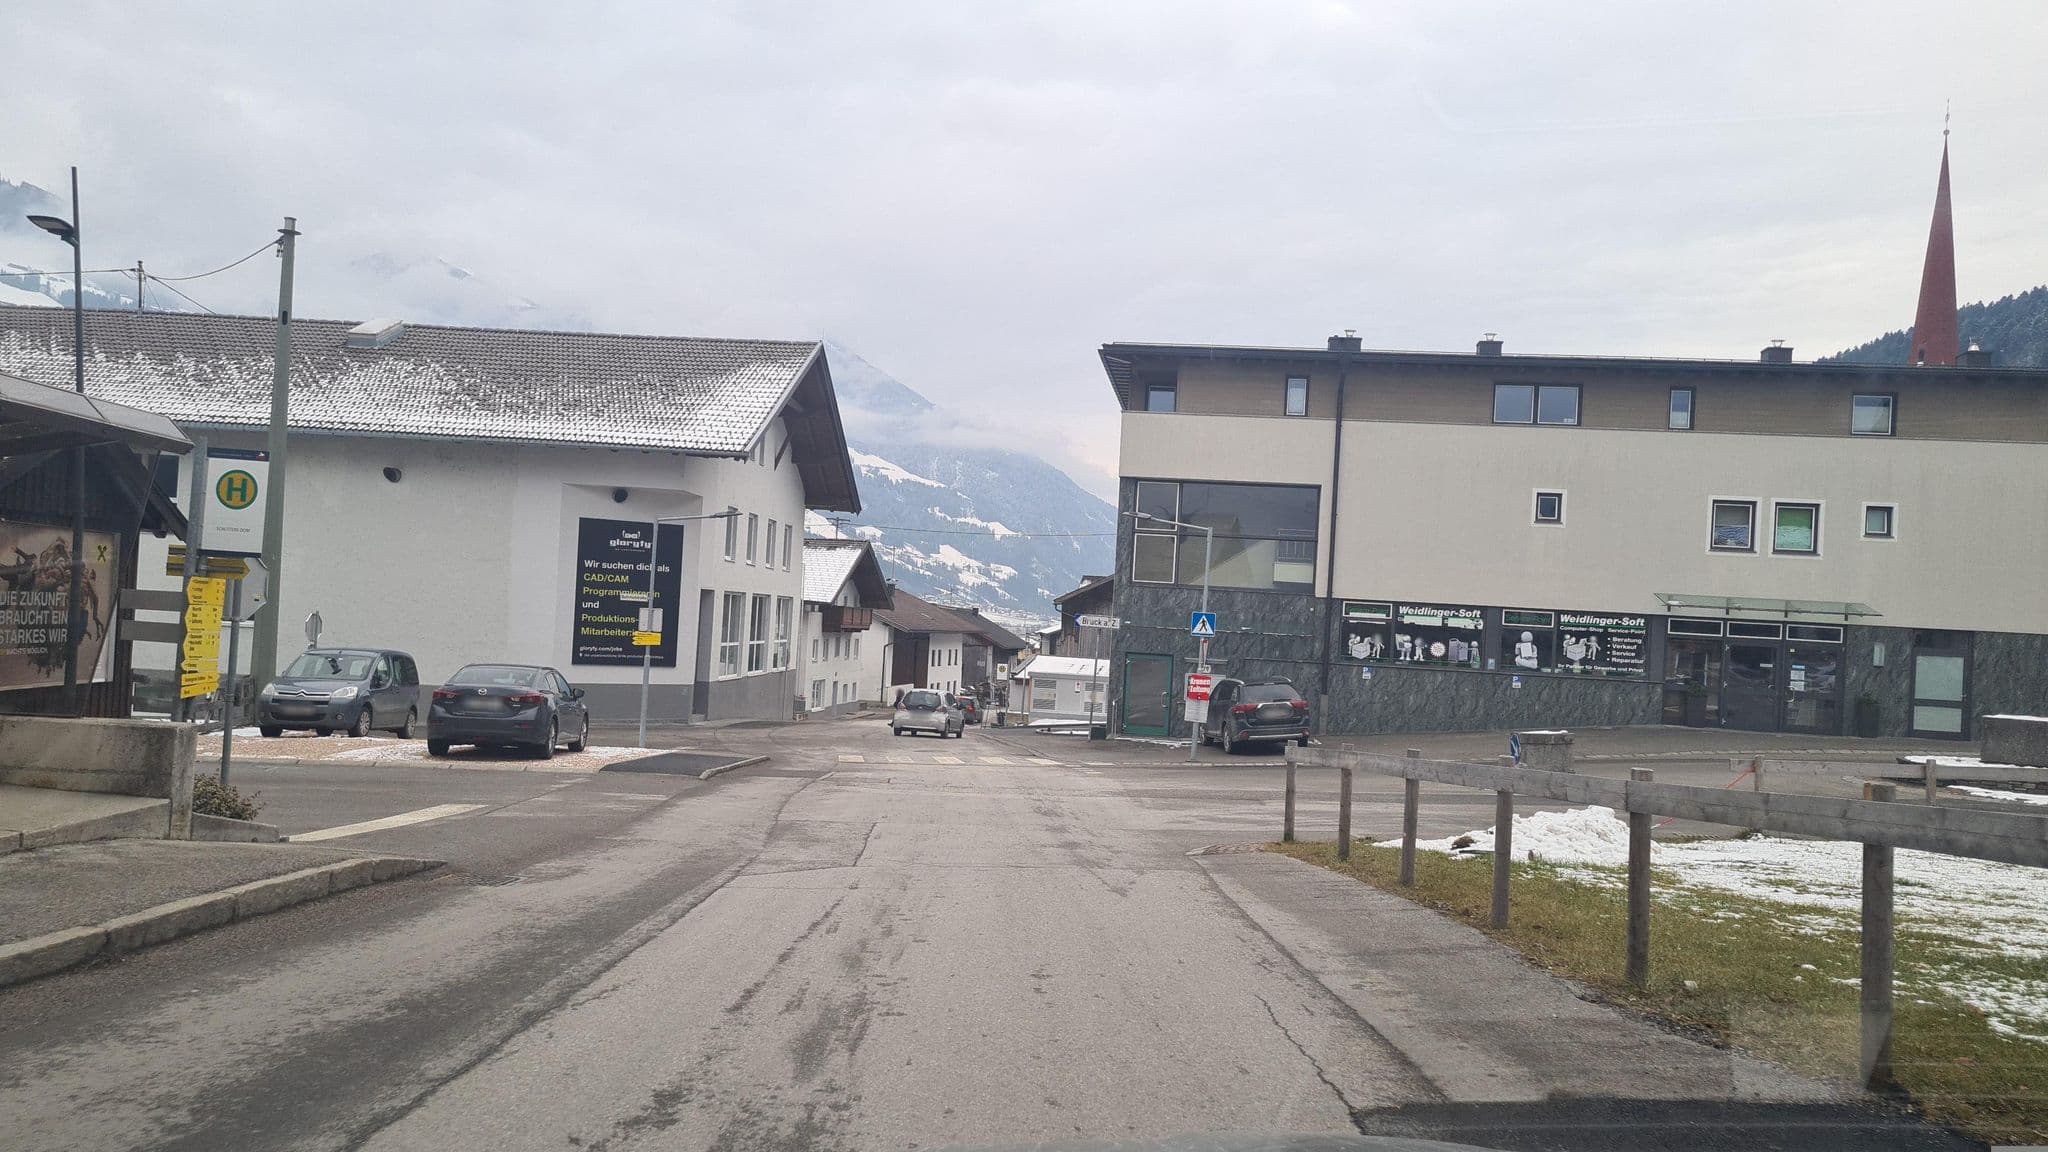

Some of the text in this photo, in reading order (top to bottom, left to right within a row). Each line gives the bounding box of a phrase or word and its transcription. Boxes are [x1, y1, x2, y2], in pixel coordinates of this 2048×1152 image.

[227, 477, 247, 501] H
[584, 560, 600, 569] Wir
[602, 561, 634, 571] suchen
[657, 564, 670, 573] als
[583, 573, 630, 583] CAD/CAM
[0, 590, 67, 606] DIE ZUKUNFT
[582, 600, 600, 608] und
[0, 610, 68, 625] BRAUCHT EIN
[1399, 606, 1481, 618] Weidlinger-Soft
[1560, 615, 1645, 626] Weidlinger-Soft
[49, 628, 68, 643] WIR
